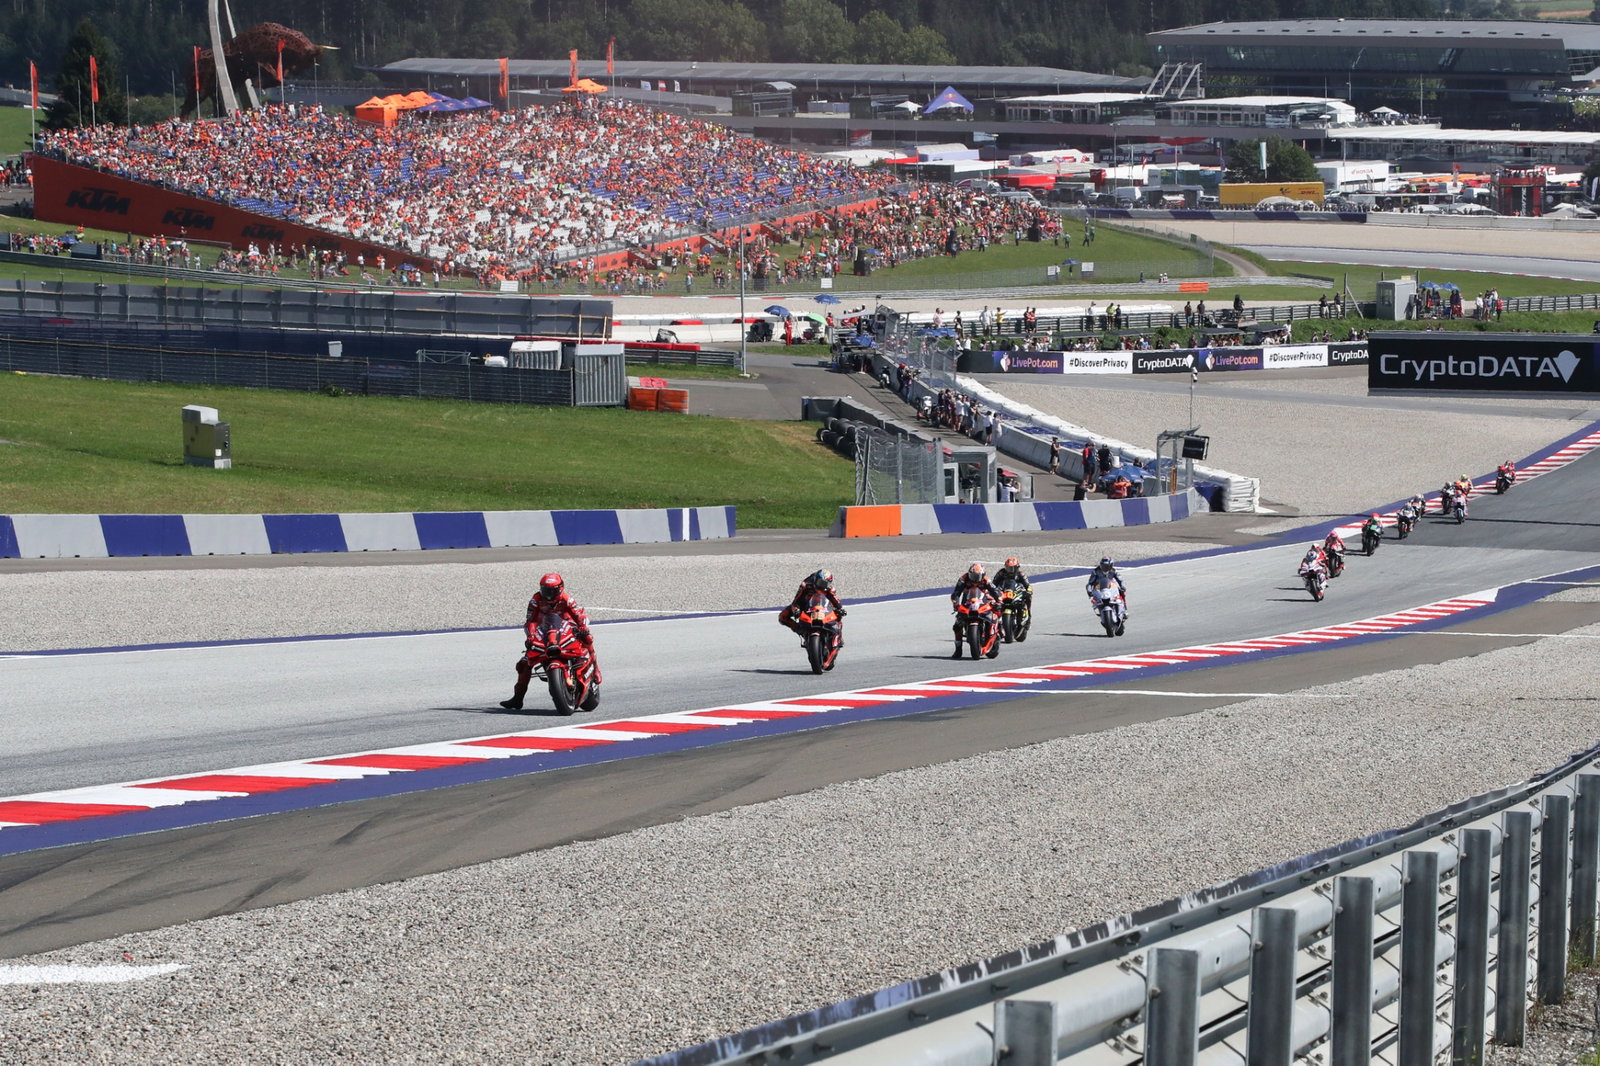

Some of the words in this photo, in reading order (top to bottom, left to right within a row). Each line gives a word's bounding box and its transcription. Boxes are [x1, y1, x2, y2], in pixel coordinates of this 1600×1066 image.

[65, 186, 133, 215] KTM
[161, 206, 216, 231] KTM
[1011, 356, 1059, 369] LivePot.com
[1069, 357, 1129, 370] #DiscoverPrivacy
[1137, 356, 1189, 371] CryptoDATA
[1215, 354, 1259, 366] LivePot.com
[1268, 351, 1324, 363] #DiscoverPrivacy
[1379, 354, 1560, 381] CryptoDATA
